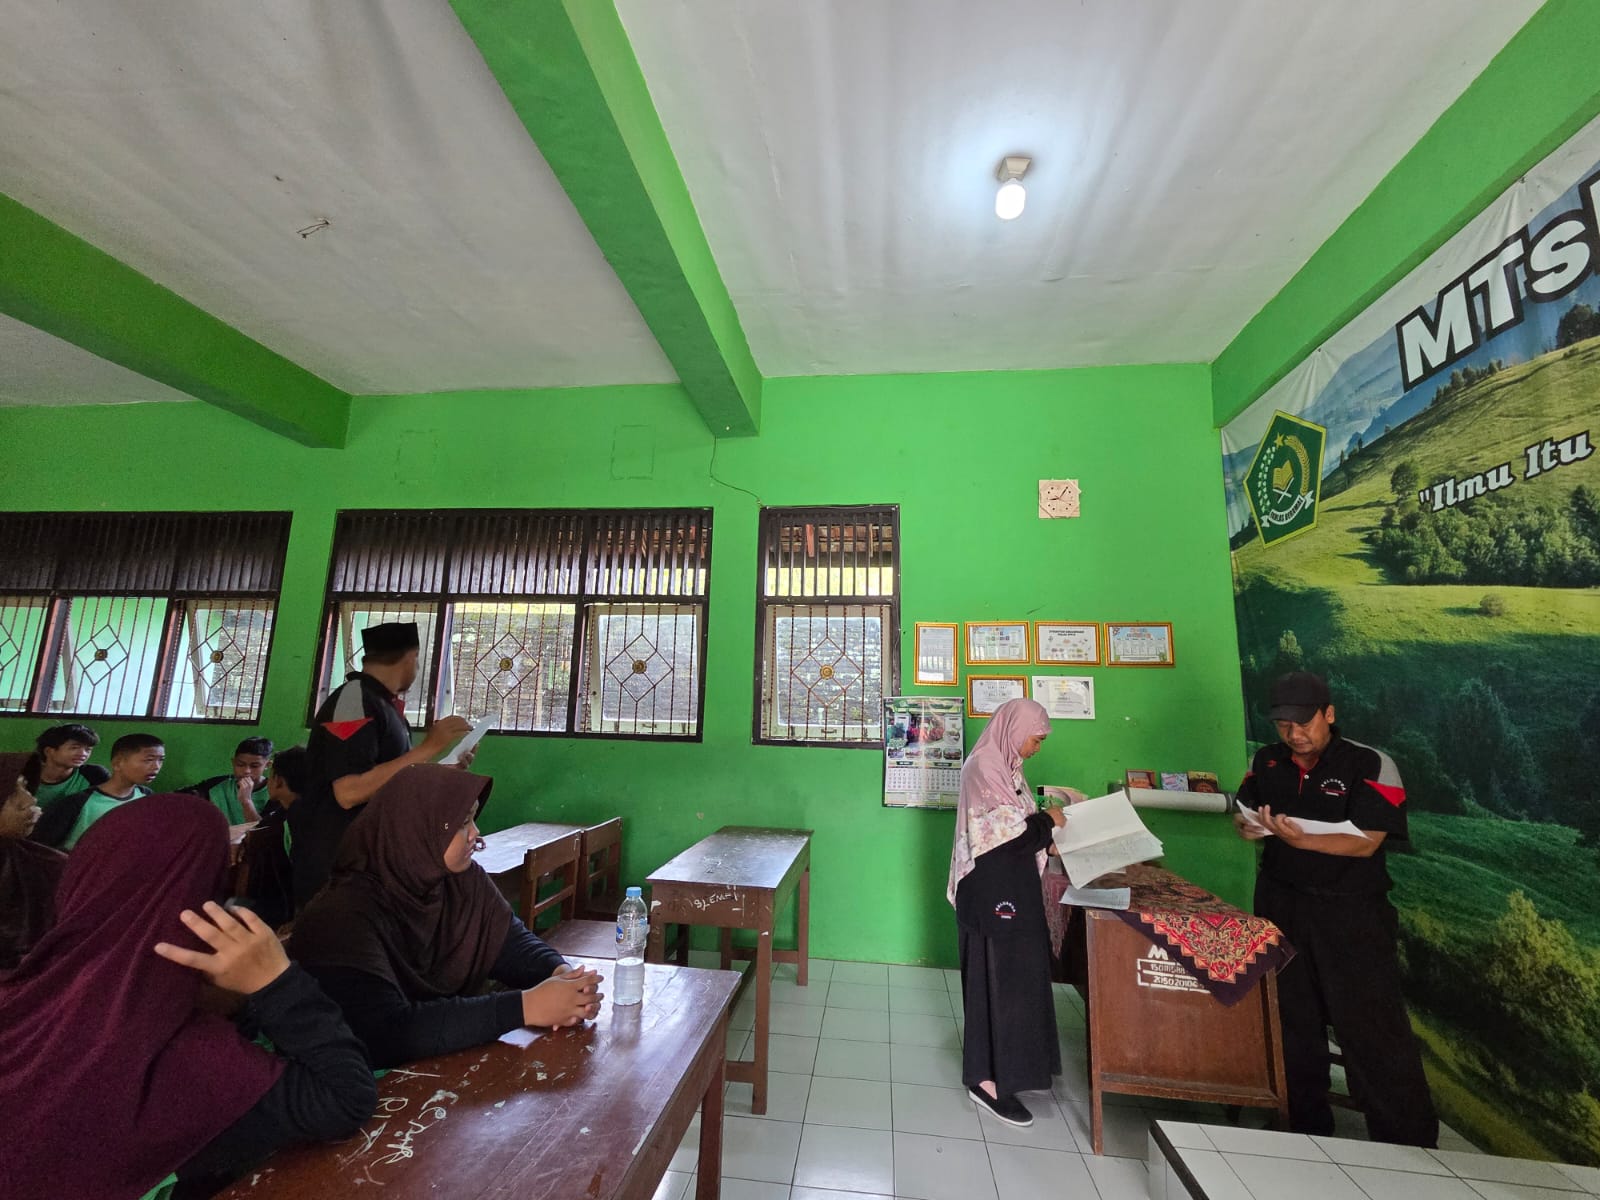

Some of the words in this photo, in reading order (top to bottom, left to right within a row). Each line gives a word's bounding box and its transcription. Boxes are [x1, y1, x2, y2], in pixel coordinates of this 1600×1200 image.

[1399, 176, 1600, 388] MTs
[1419, 463, 1515, 512] "Ilmu
[1524, 431, 1594, 480] Itu
